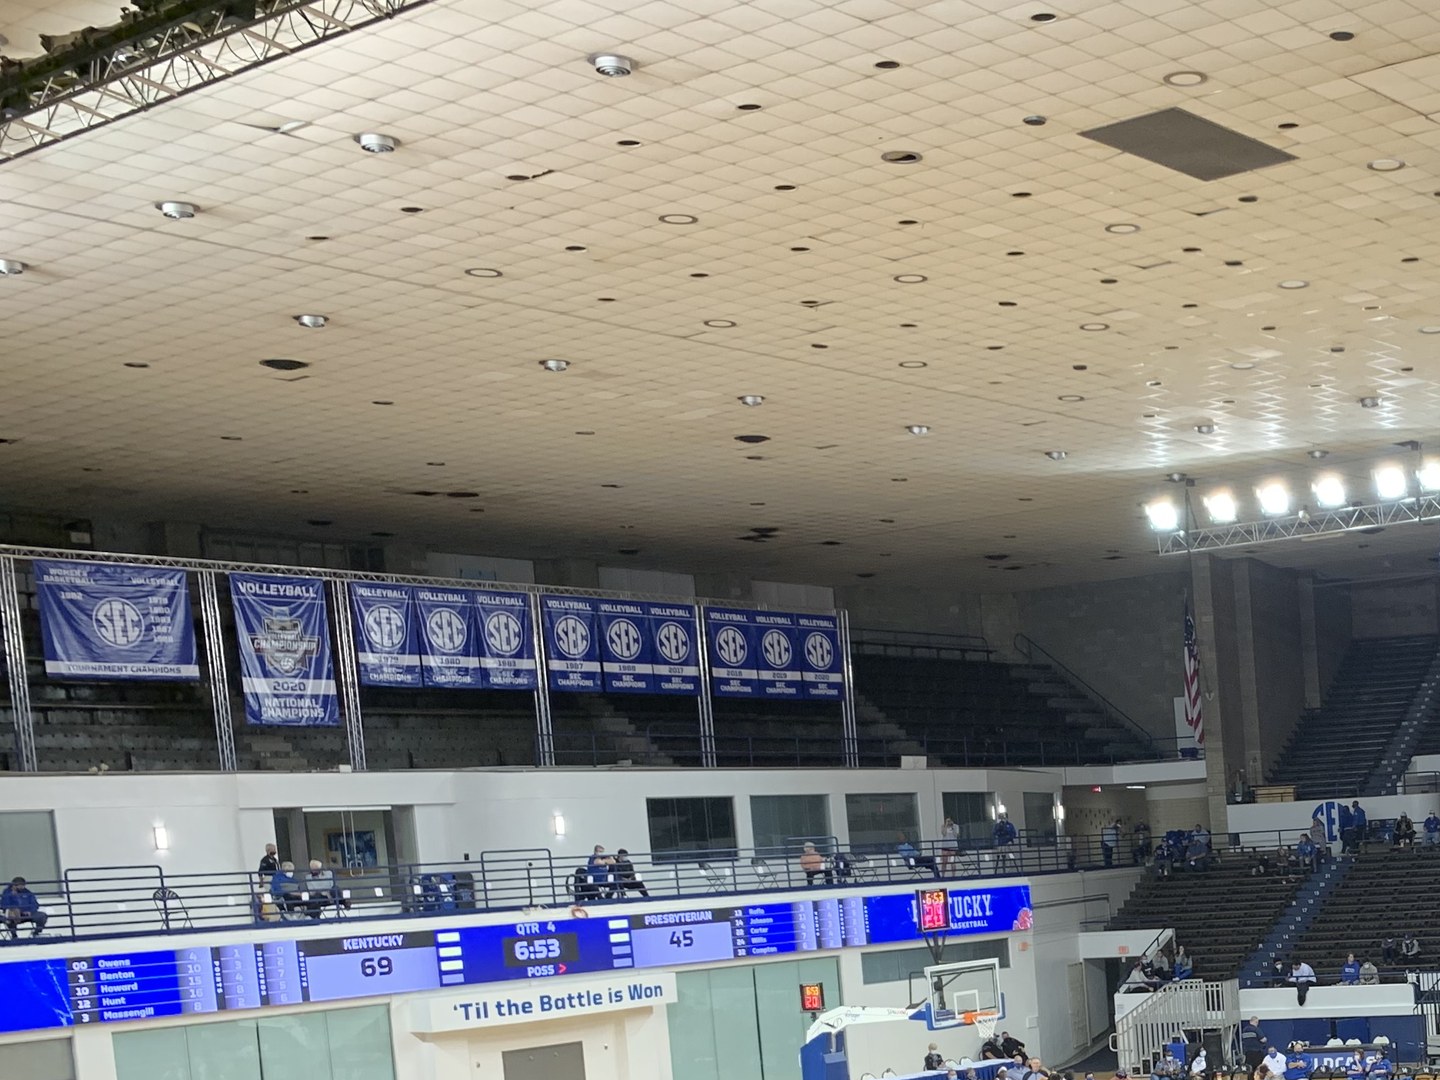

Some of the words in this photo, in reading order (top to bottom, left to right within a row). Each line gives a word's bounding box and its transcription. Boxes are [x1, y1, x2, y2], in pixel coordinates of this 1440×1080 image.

[238, 582, 316, 597] VOLLEYBALL
[357, 588, 408, 599] VOLLEYBALL
[419, 592, 467, 602] VOLLEYBALL
[477, 595, 524, 605] VOLLEYBALL
[547, 600, 591, 610] VOLLEYBALL
[601, 604, 642, 614] VOLLEYBALL
[651, 608, 690, 617] VOLLEYBALL
[97, 601, 140, 645] SEC
[710, 612, 747, 622] VOLLEYBALL
[756, 616, 791, 625] VOLLEYBALL
[799, 619, 834, 627] VOLLEYBALL
[367, 608, 400, 646] SEC
[431, 612, 463, 650] SEC
[488, 615, 519, 652] SEC
[558, 618, 587, 655] SEC
[610, 622, 639, 657] SEC
[660, 625, 686, 659] SEC
[254, 639, 317, 651] CHAMPIONSHIP
[720, 629, 745, 663] SEC
[764, 632, 789, 665] SEC
[807, 635, 830, 667] SEC
[131, 666, 181, 674] CHAMPIONS
[273, 681, 306, 691] 2020
[265, 698, 319, 708] NATIONAL
[261, 708, 324, 718] CHAMPIONS
[644, 911, 713, 926] PRESBYTERIAN
[516, 922, 540, 936] QTR
[547, 921, 556, 934] 4
[343, 935, 404, 951] KENTUCKY
[669, 930, 694, 948] 45
[514, 939, 561, 962] 6:53
[72, 961, 88, 971] 00
[98, 958, 130, 968] Owens
[360, 956, 393, 977] 69
[527, 965, 555, 977] POSS
[75, 987, 89, 996] 10
[100, 982, 138, 994] Howard
[278, 969, 285, 977] 7
[77, 974, 85, 983] 1
[100, 970, 135, 981] Benton
[213, 961, 223, 993] POINTS
[77, 1000, 91, 1009] 12
[102, 995, 126, 1006] Hunt
[495, 996, 533, 1017] the
[540, 988, 603, 1012] Battle
[608, 987, 623, 1002] is
[628, 983, 663, 1001] Won
[82, 1013, 89, 1023] 3
[103, 1007, 154, 1021] Massengill
